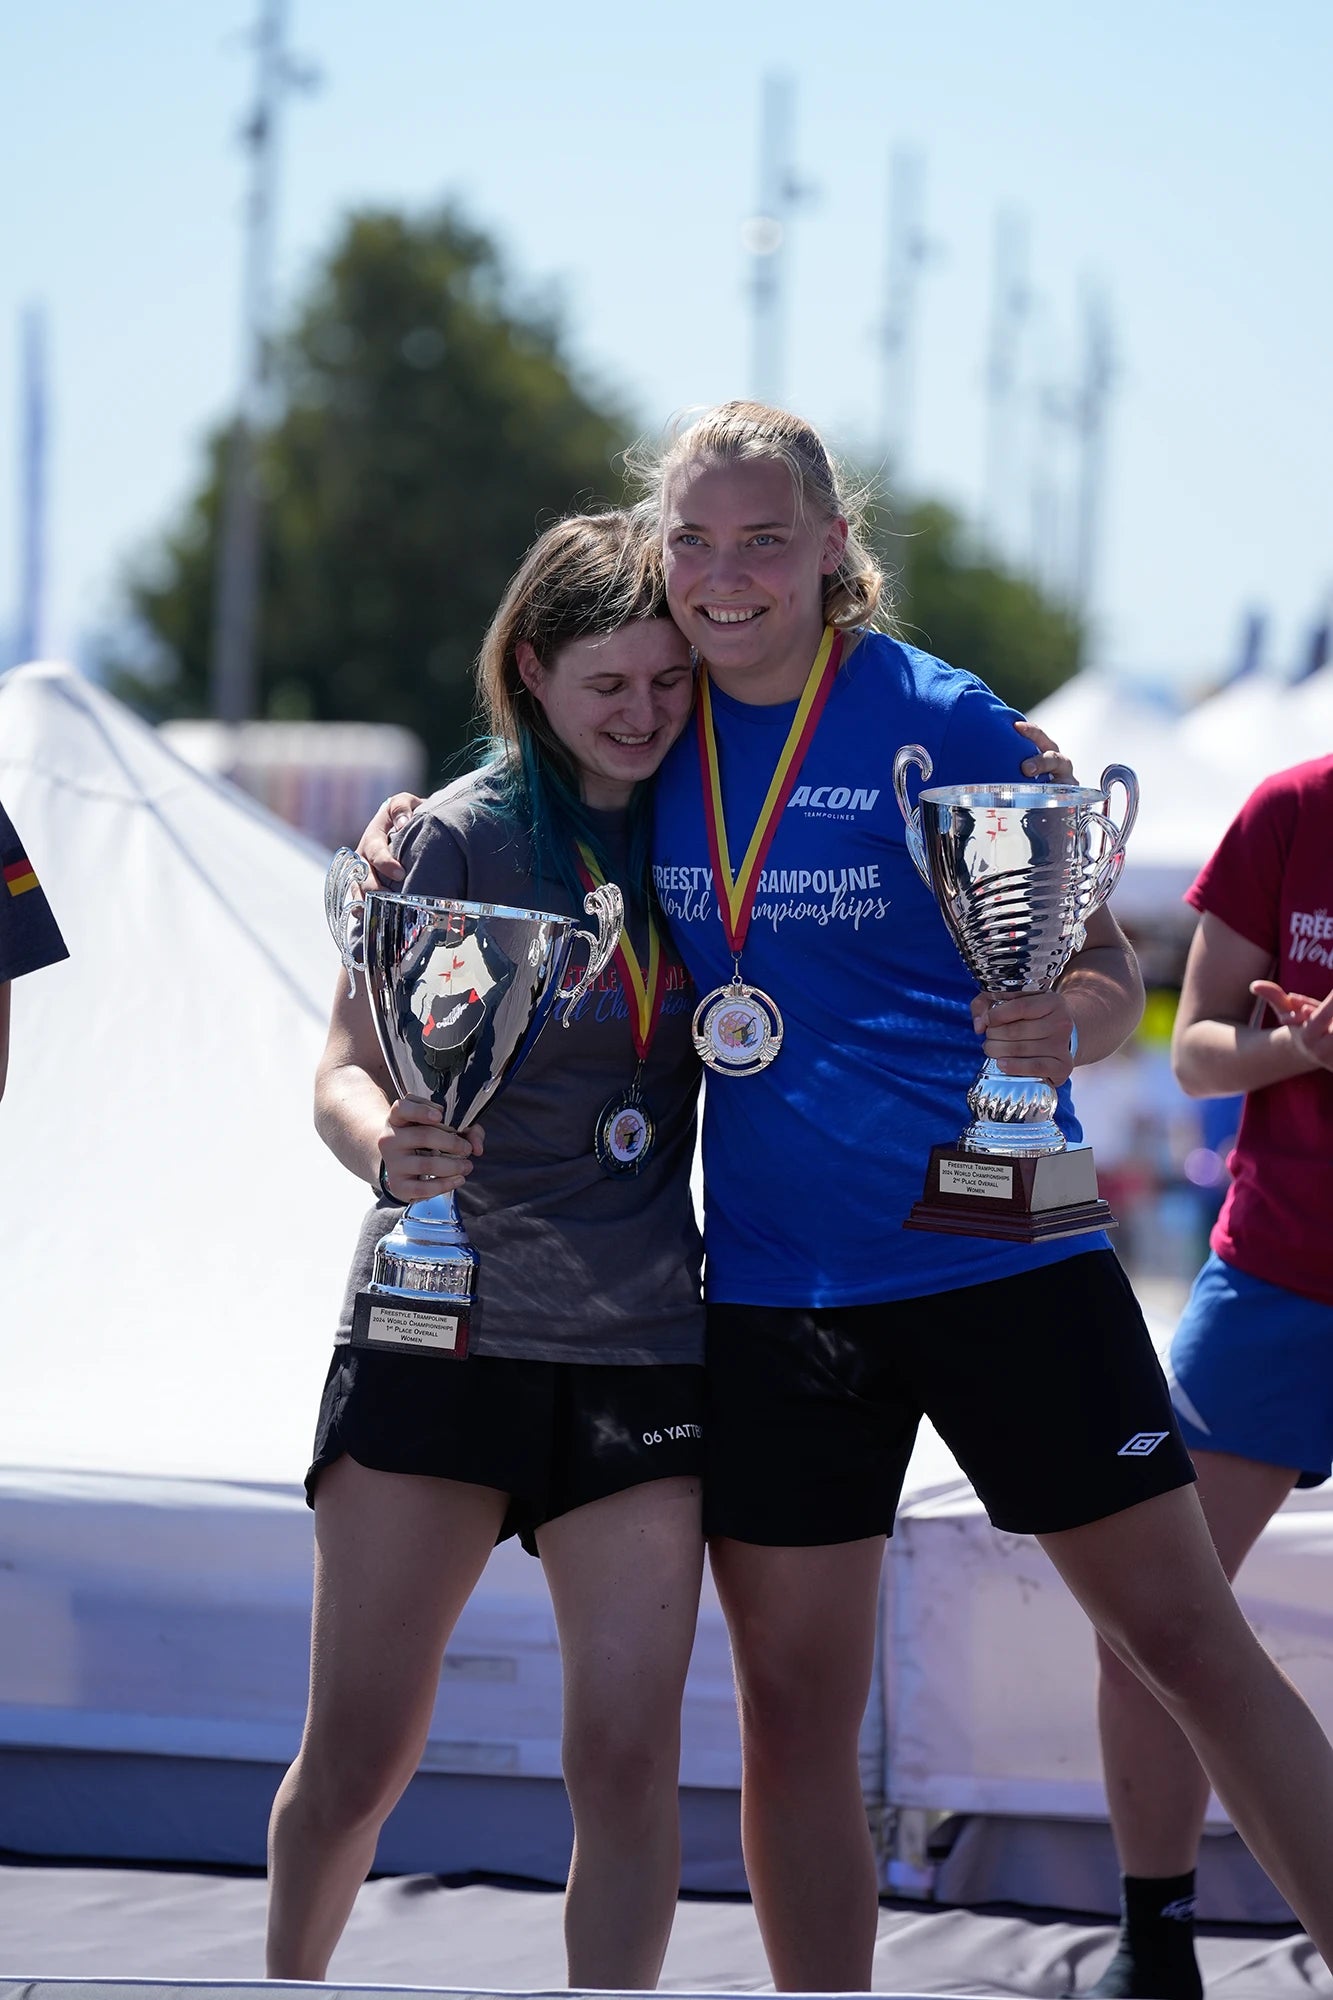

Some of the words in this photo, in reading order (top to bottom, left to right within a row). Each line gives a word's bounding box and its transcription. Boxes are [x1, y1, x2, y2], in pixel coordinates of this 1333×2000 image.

[786, 786, 880, 811] ACON
[804, 812, 855, 821] TRAMPOLINES
[757, 864, 881, 894] RAMPOLINE
[642, 1430, 663, 1445] 06
